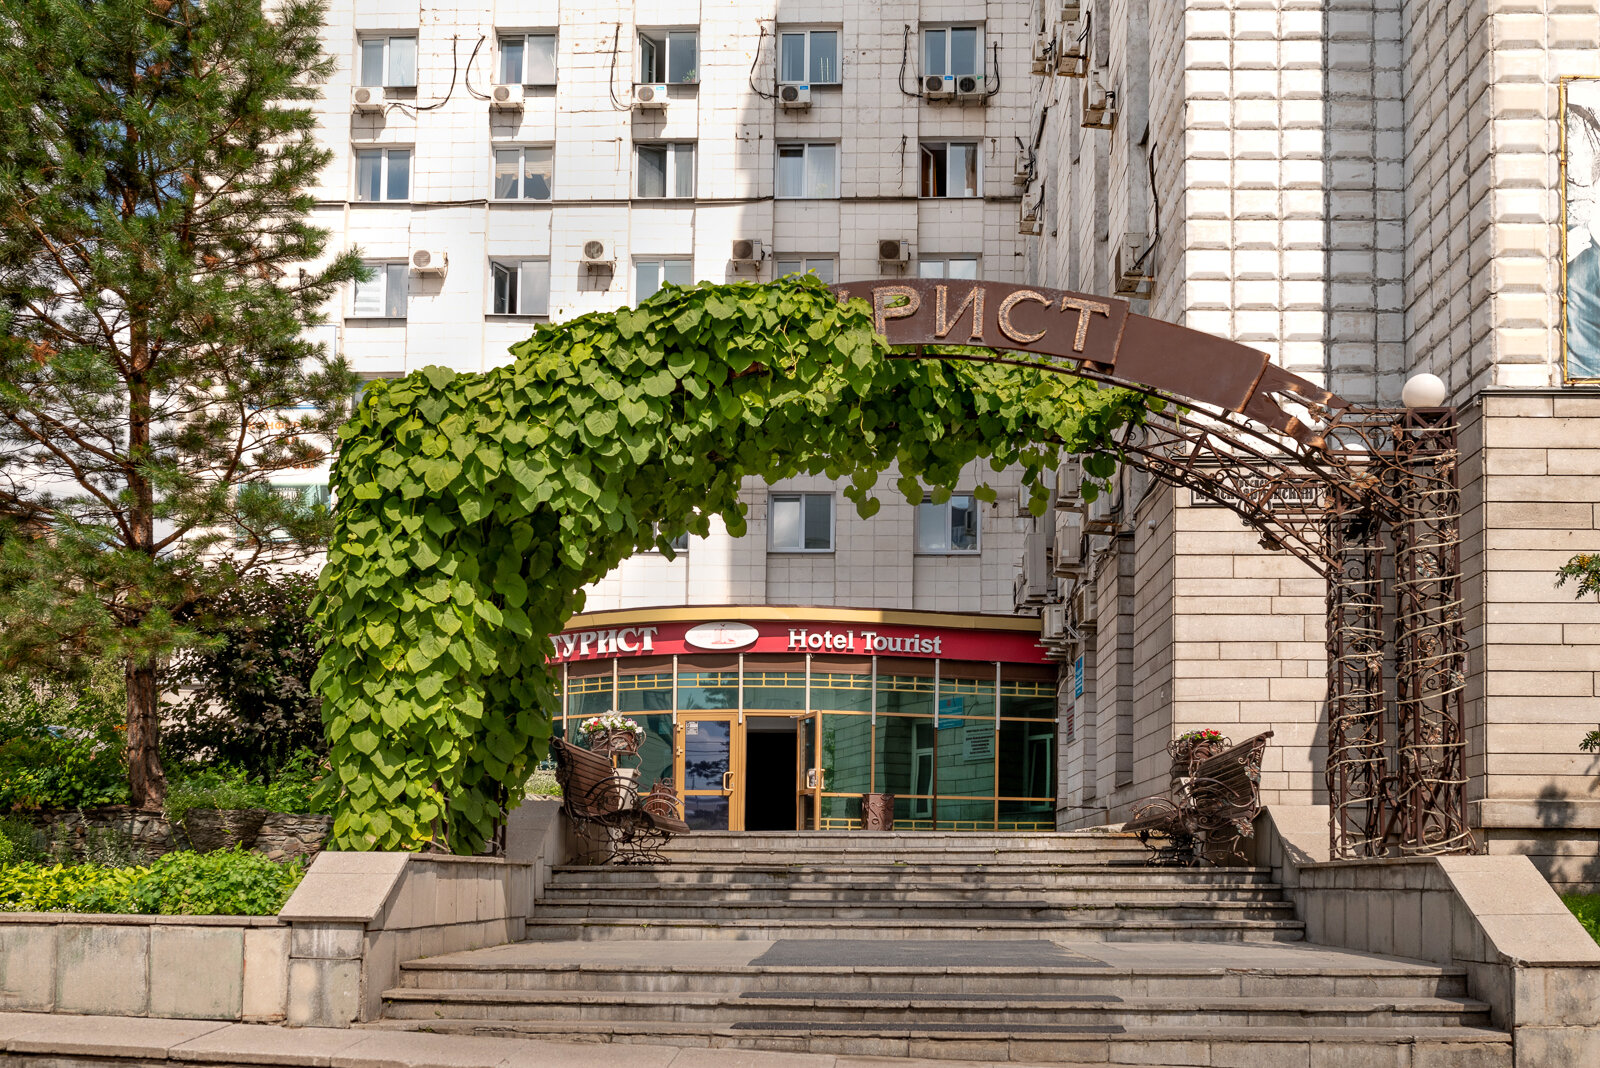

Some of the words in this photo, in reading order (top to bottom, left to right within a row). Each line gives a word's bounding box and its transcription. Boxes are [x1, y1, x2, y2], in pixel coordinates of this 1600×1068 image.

[837, 284, 1111, 352] РИСТ
[549, 626, 659, 659] ТУРИСТ
[788, 628, 855, 650] Hotel
[861, 630, 942, 654] Tourist
